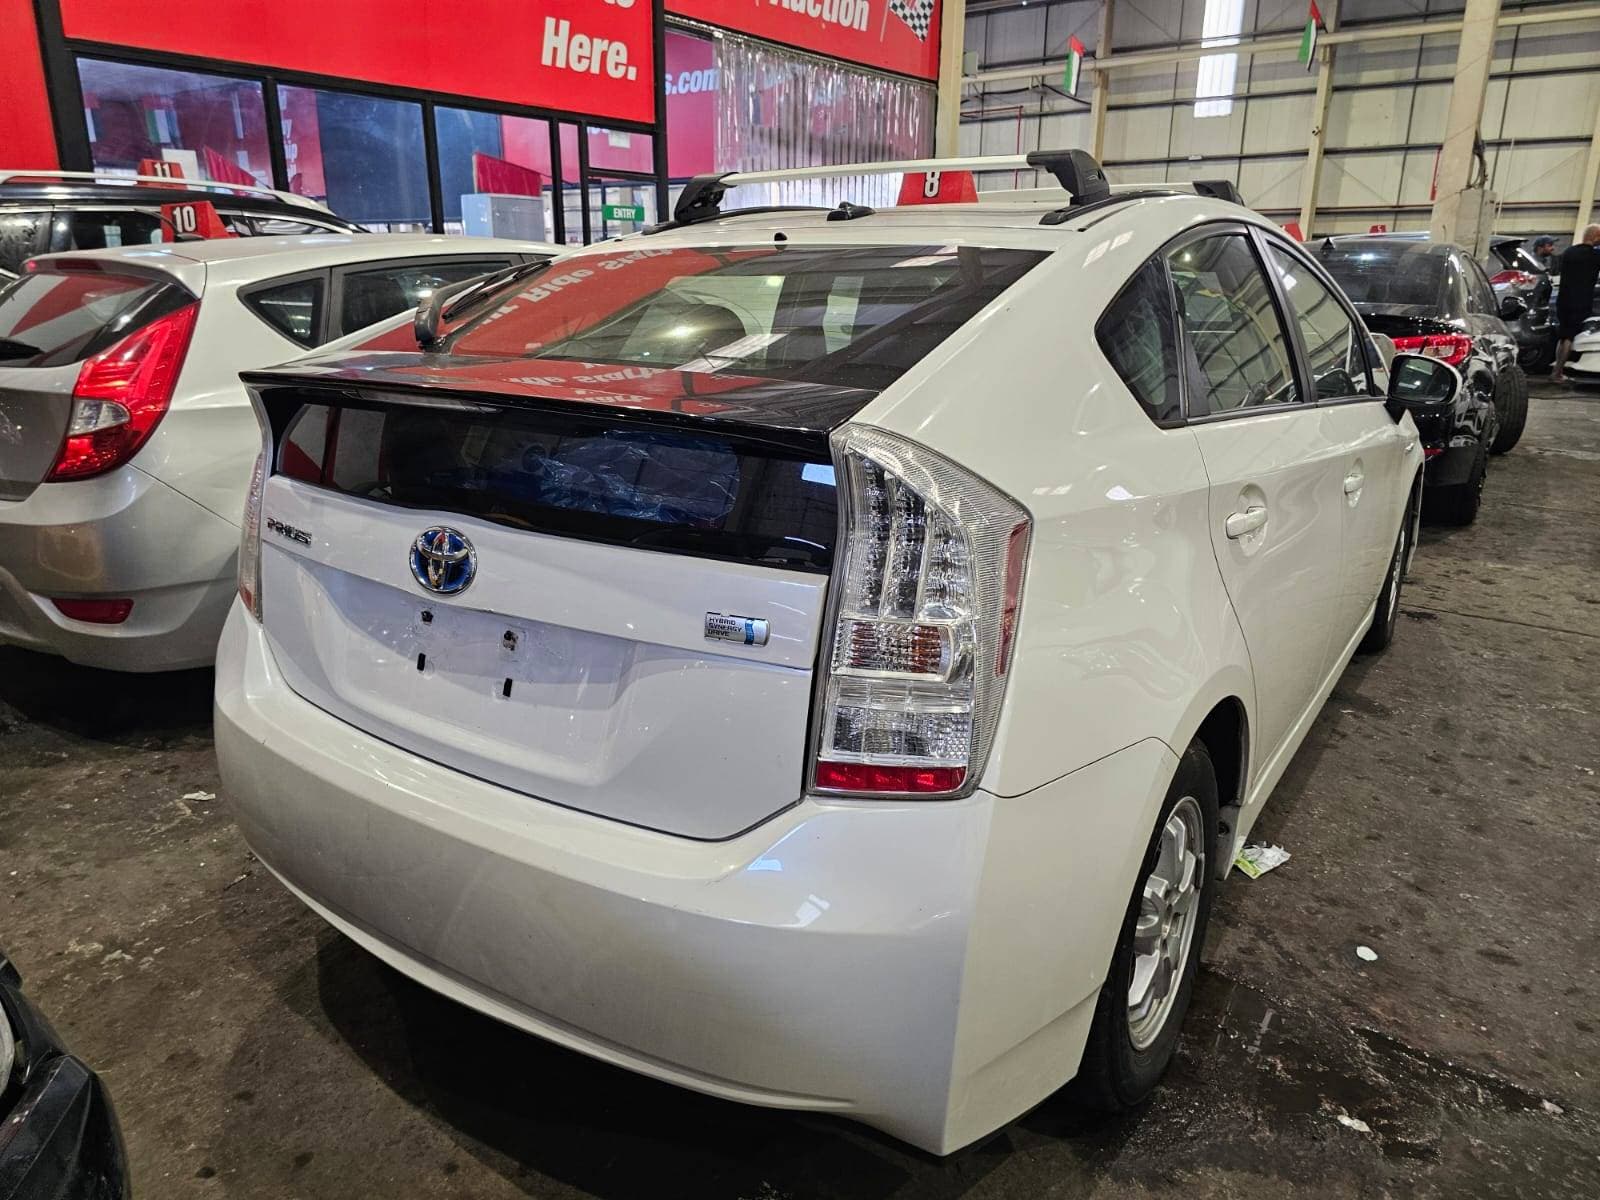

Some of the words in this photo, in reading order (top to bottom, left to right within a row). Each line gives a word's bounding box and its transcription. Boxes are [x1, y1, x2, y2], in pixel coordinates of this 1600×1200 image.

[541, 16, 638, 81] Here.
[154, 162, 171, 178] 11
[924, 169, 941, 198] 8
[172, 205, 196, 233] 10
[613, 207, 636, 219] ENTRY
[708, 623, 743, 632] SYNERGY
[709, 616, 736, 626] HYBRID
[707, 629, 730, 637] DRIVE
